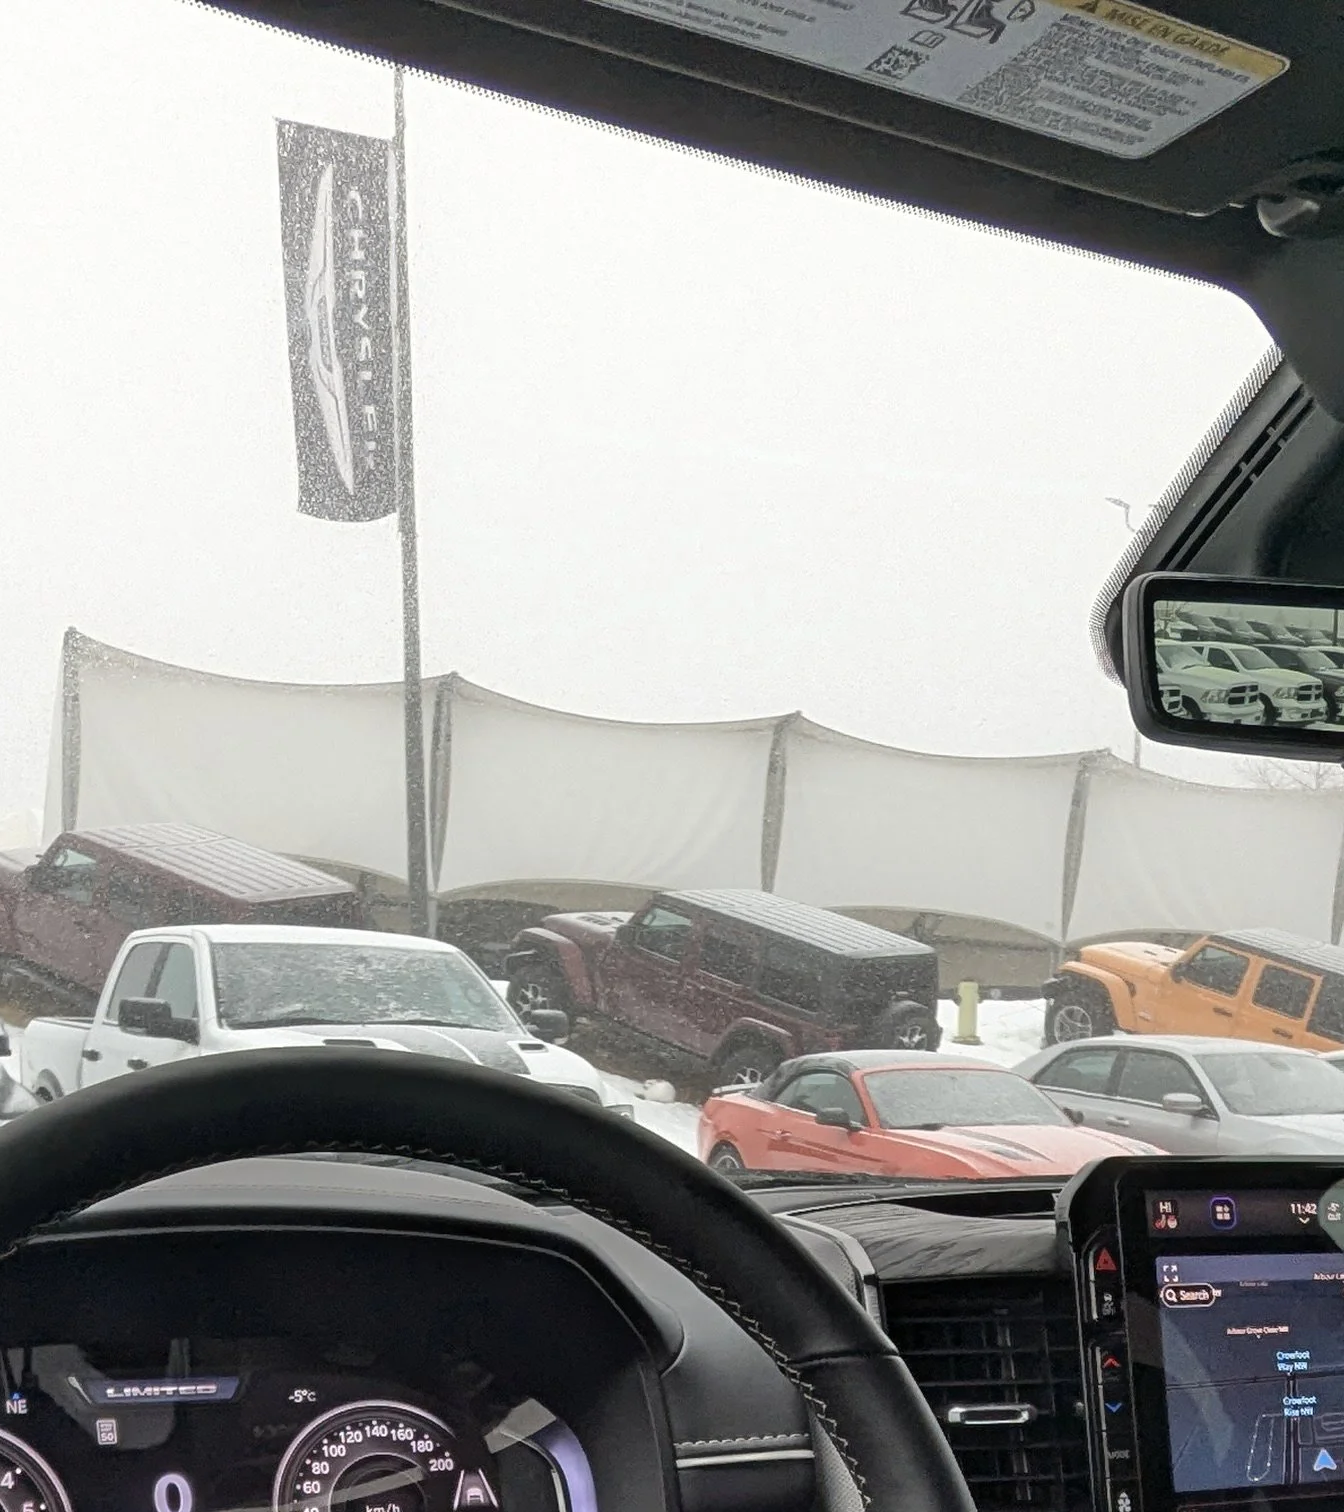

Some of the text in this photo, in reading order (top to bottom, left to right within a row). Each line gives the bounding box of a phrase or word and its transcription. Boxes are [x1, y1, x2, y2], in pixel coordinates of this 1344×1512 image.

[346, 188, 379, 473] CHRYSLER
[1159, 1201, 1172, 1213] HI
[1290, 1203, 1318, 1215] 11:42
[1179, 1289, 1210, 1301] Search
[1276, 1350, 1311, 1361] Crowfoot
[1277, 1361, 1308, 1373] Way NW
[106, 1384, 218, 1399] LIMITED
[6, 1400, 29, 1415] NE
[1283, 1396, 1317, 1406] Crowfoot
[1299, 1407, 1314, 1416] NW
[100, 1432, 114, 1442] 50
[339, 1430, 363, 1444] 120
[365, 1425, 388, 1438] 140
[390, 1428, 414, 1441] 160
[322, 1445, 346, 1458] 100
[410, 1440, 434, 1453] 180
[311, 1462, 329, 1475] 80
[429, 1458, 454, 1472] 200
[0, 1471, 15, 1489] 4
[303, 1481, 321, 1494] 60
